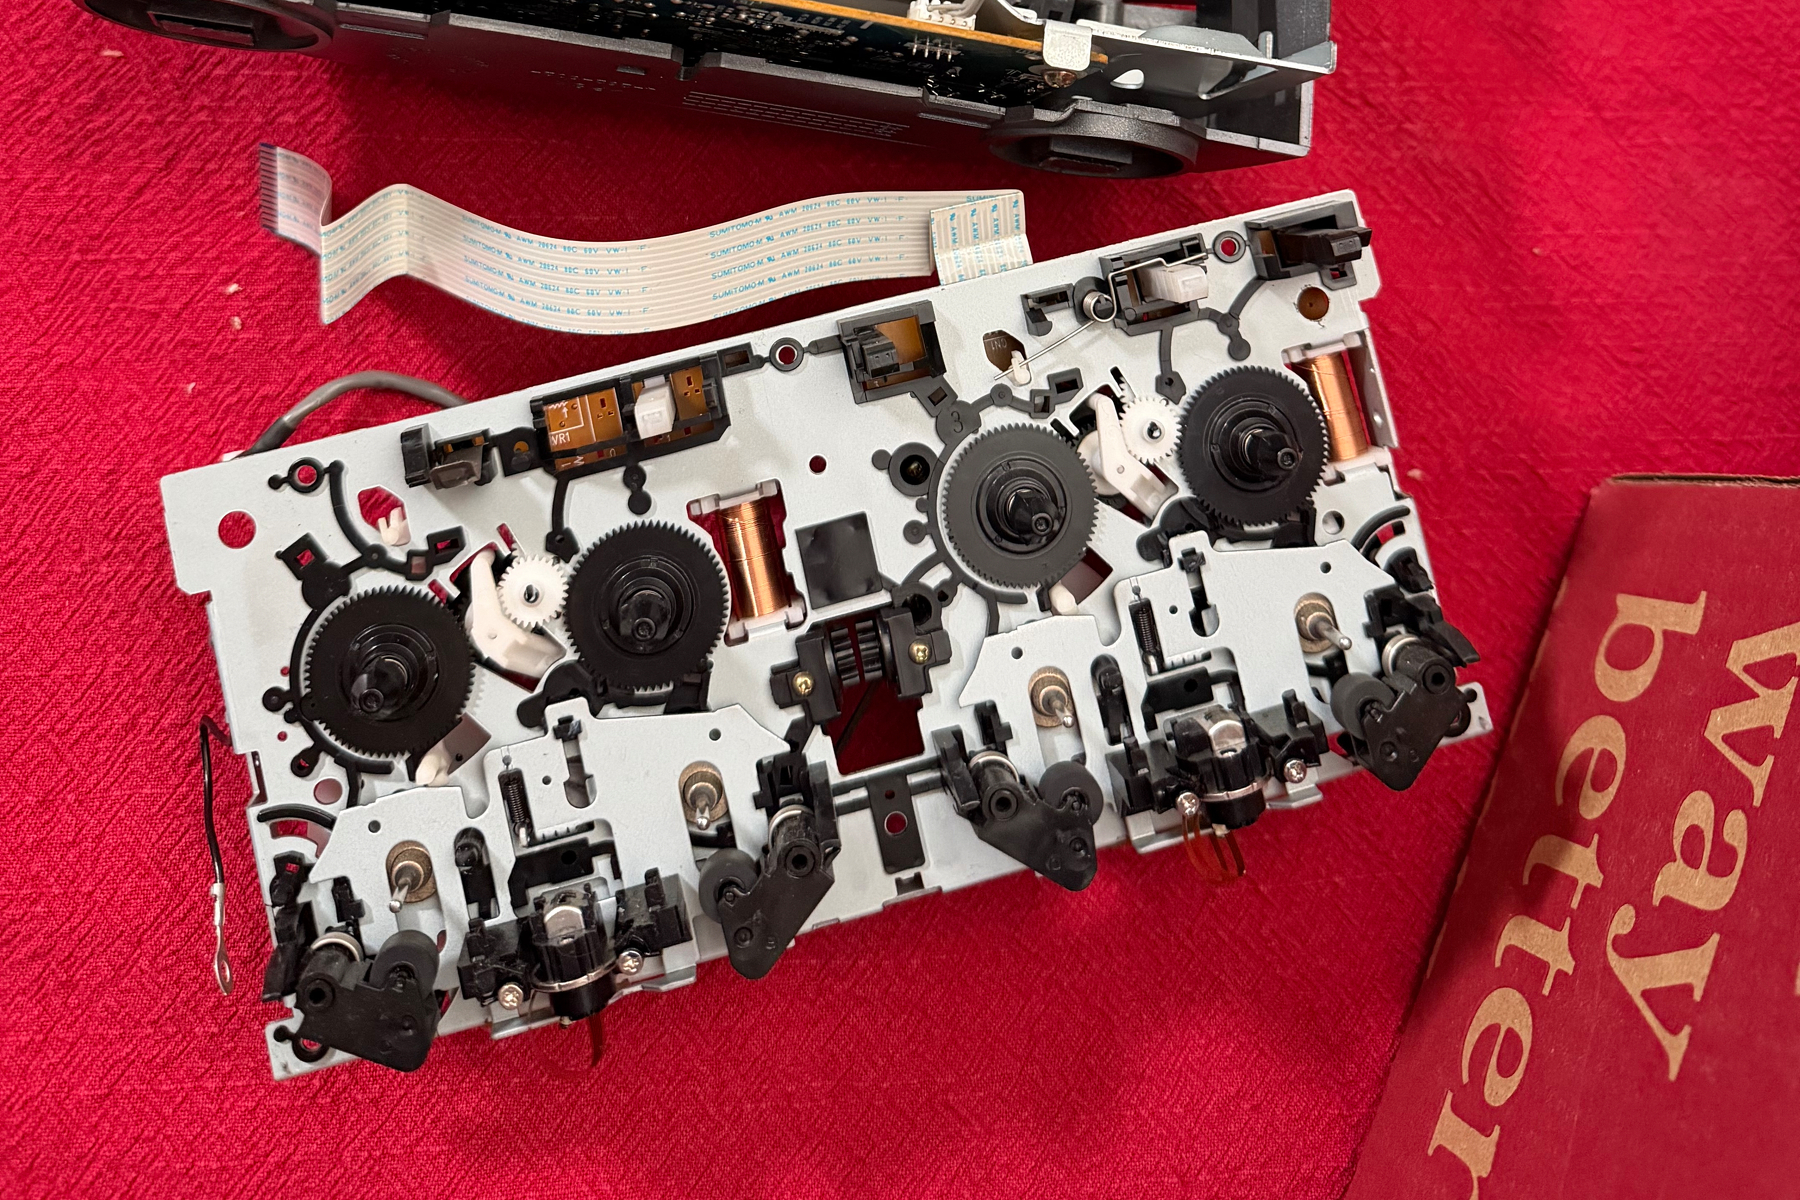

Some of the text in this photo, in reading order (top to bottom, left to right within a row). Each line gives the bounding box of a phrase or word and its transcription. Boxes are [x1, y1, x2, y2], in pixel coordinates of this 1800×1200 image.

[778, 206, 798, 218] AWM
[780, 227, 798, 238] AWM
[516, 236, 534, 246] AWM
[780, 248, 799, 258] AWM
[518, 256, 535, 266] AWM
[782, 268, 800, 279] AWM
[518, 277, 536, 288] AWM
[520, 298, 537, 308] AWM
[552, 431, 571, 446] VR1
[1606, 621, 1800, 1081] way
[1428, 590, 1706, 1200] better
